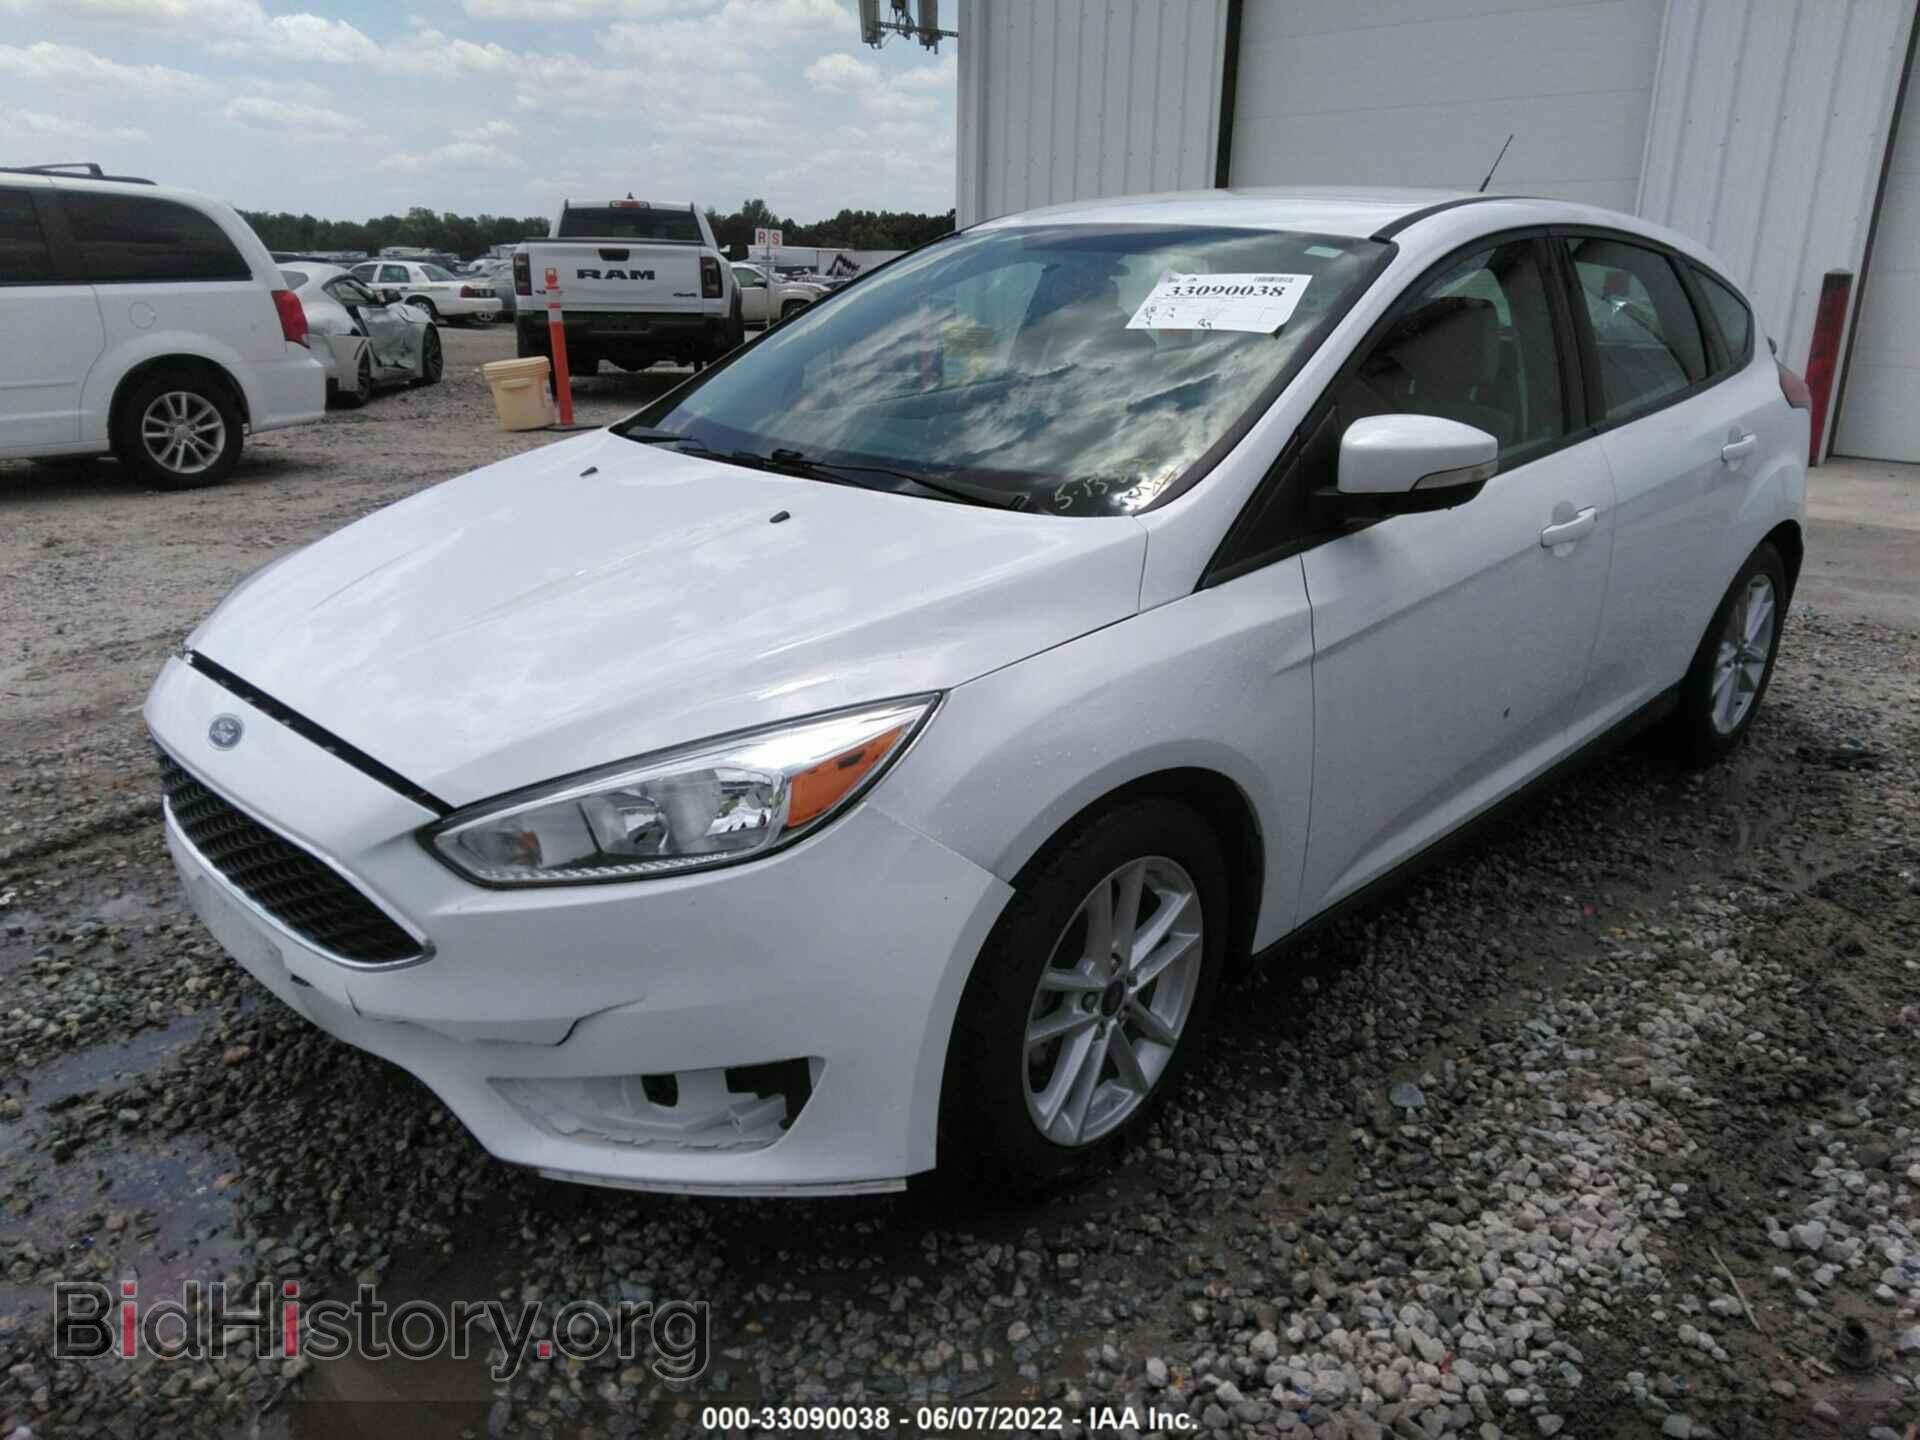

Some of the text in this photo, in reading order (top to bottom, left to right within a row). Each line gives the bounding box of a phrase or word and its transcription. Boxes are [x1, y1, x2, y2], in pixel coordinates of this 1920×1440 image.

[758, 231, 780, 245] R S
[577, 269, 655, 280] RAM
[1165, 285, 1286, 297] 33090038
